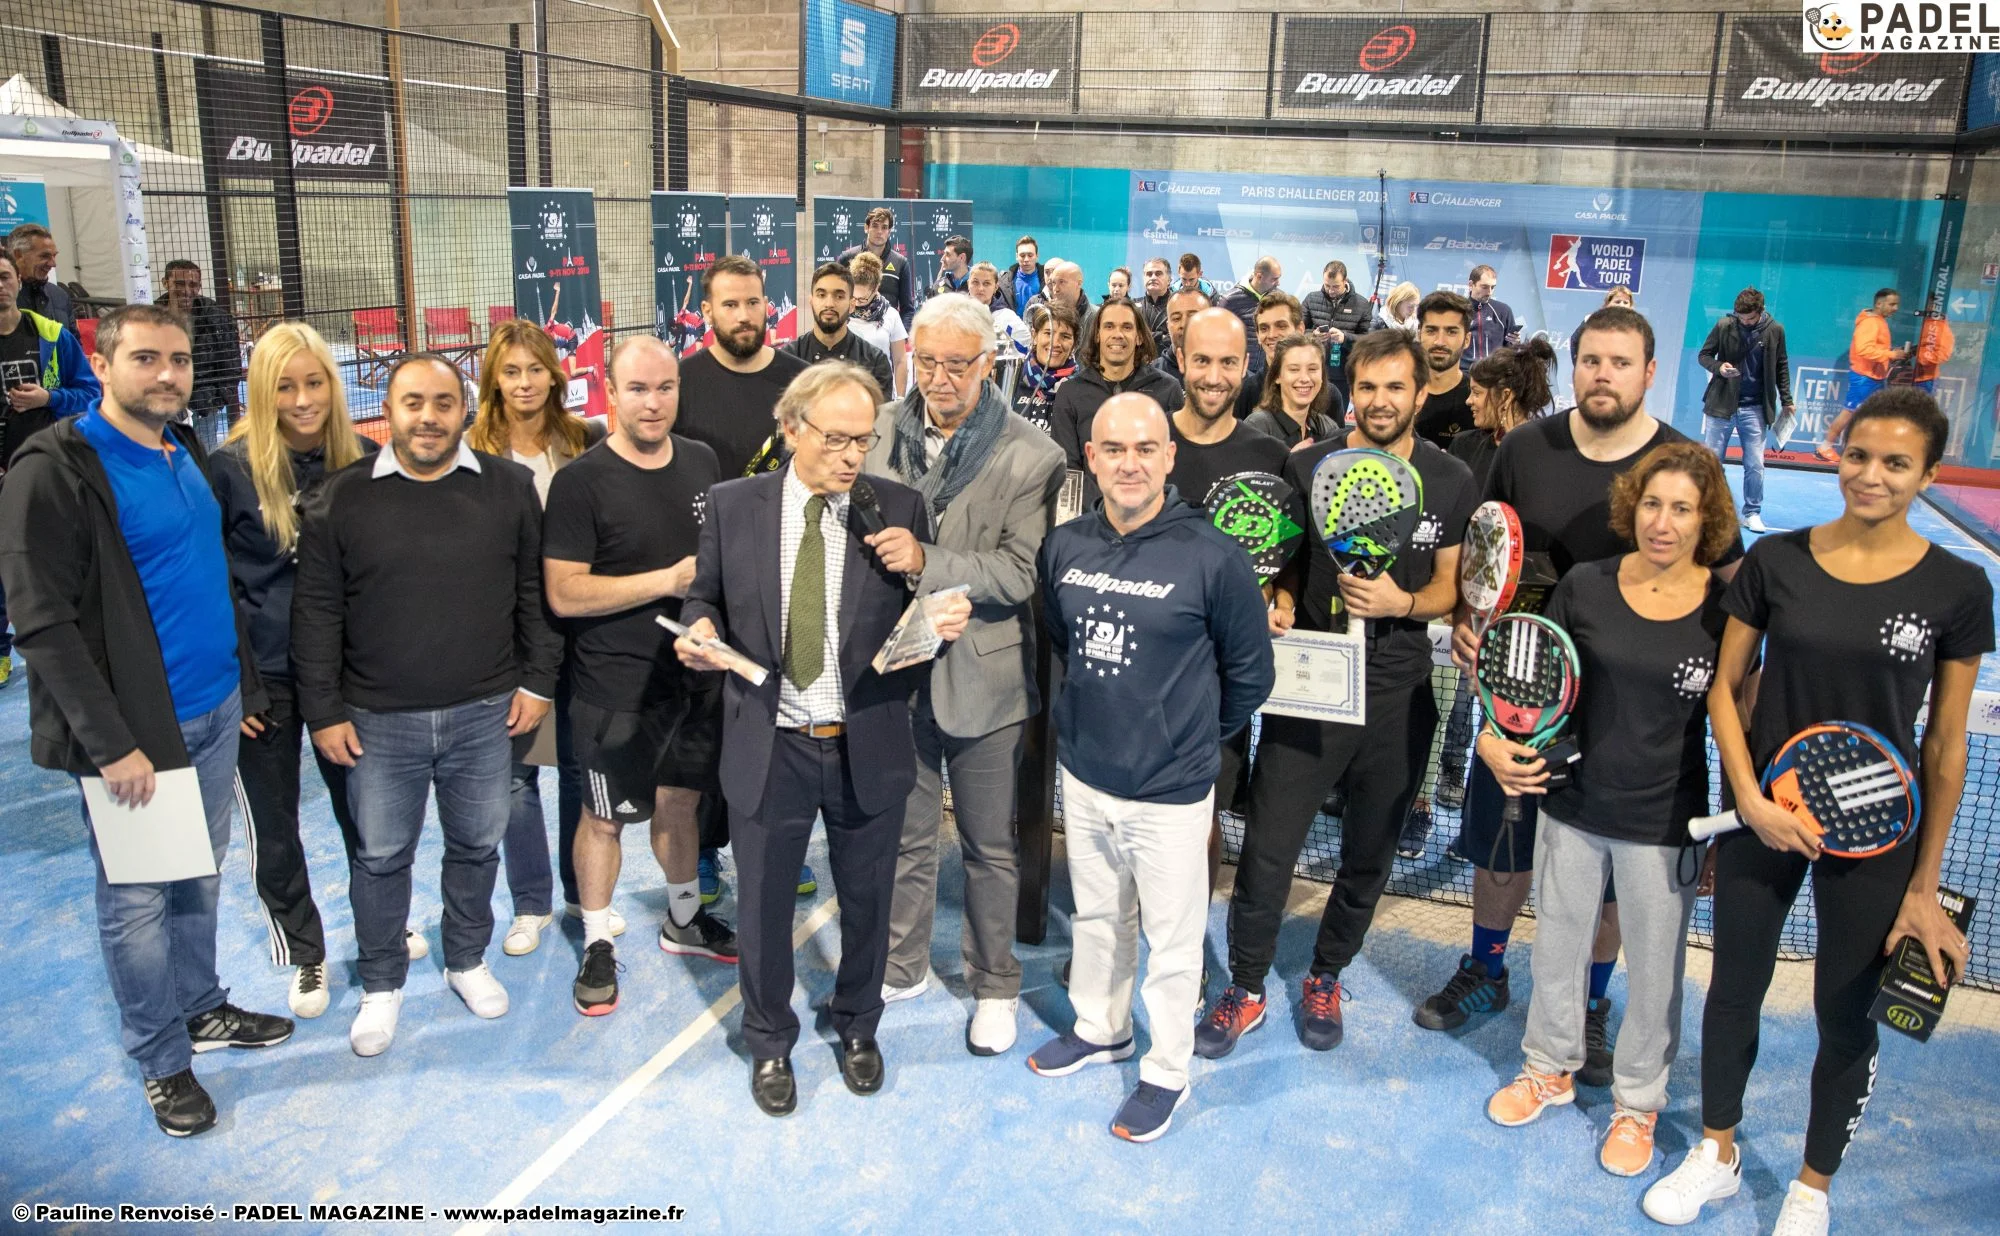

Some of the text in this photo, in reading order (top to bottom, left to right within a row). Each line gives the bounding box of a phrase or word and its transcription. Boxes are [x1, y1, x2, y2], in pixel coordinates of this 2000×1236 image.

[831, 73, 871, 93] SEAT
[919, 68, 1060, 93] Bullpadel
[1294, 72, 1463, 100] Bullpadel
[1741, 77, 1945, 108] Bullpadel
[1241, 185, 1275, 199] PARIS
[1278, 187, 1355, 202] CHALLENGER
[1575, 211, 1628, 222] CASA PADEL
[1143, 228, 1178, 240] Estrella
[1197, 227, 1254, 238] HEAD
[1393, 230, 1406, 239] TEN
[1392, 243, 1405, 252] NIS
[1591, 244, 1634, 258] WORLD
[1594, 258, 1633, 271] PADEL
[1599, 271, 1630, 285] TOUR
[1805, 379, 1840, 400] TEN
[1799, 412, 1835, 433] NIS
[1061, 568, 1175, 599] Bullpadel
